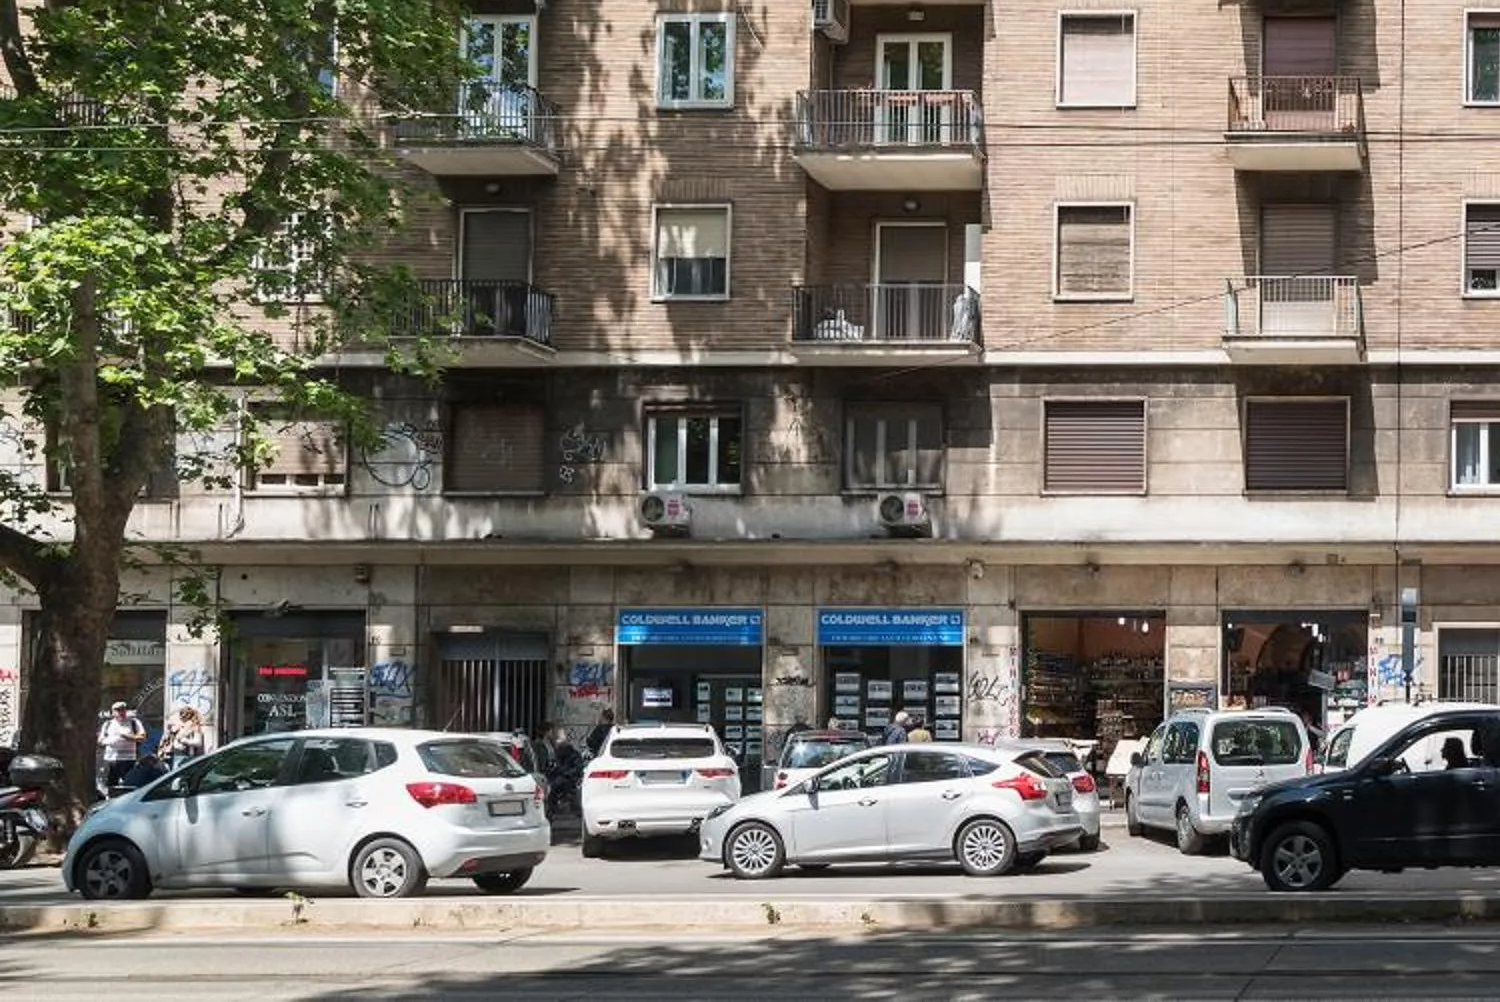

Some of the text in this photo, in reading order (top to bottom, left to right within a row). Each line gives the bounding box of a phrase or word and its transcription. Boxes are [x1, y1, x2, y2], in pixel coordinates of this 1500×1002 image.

[621, 614, 747, 626] COLDWELL BANKER
[821, 614, 947, 626] COLDWELL BANKER
[269, 703, 297, 717] ASL
